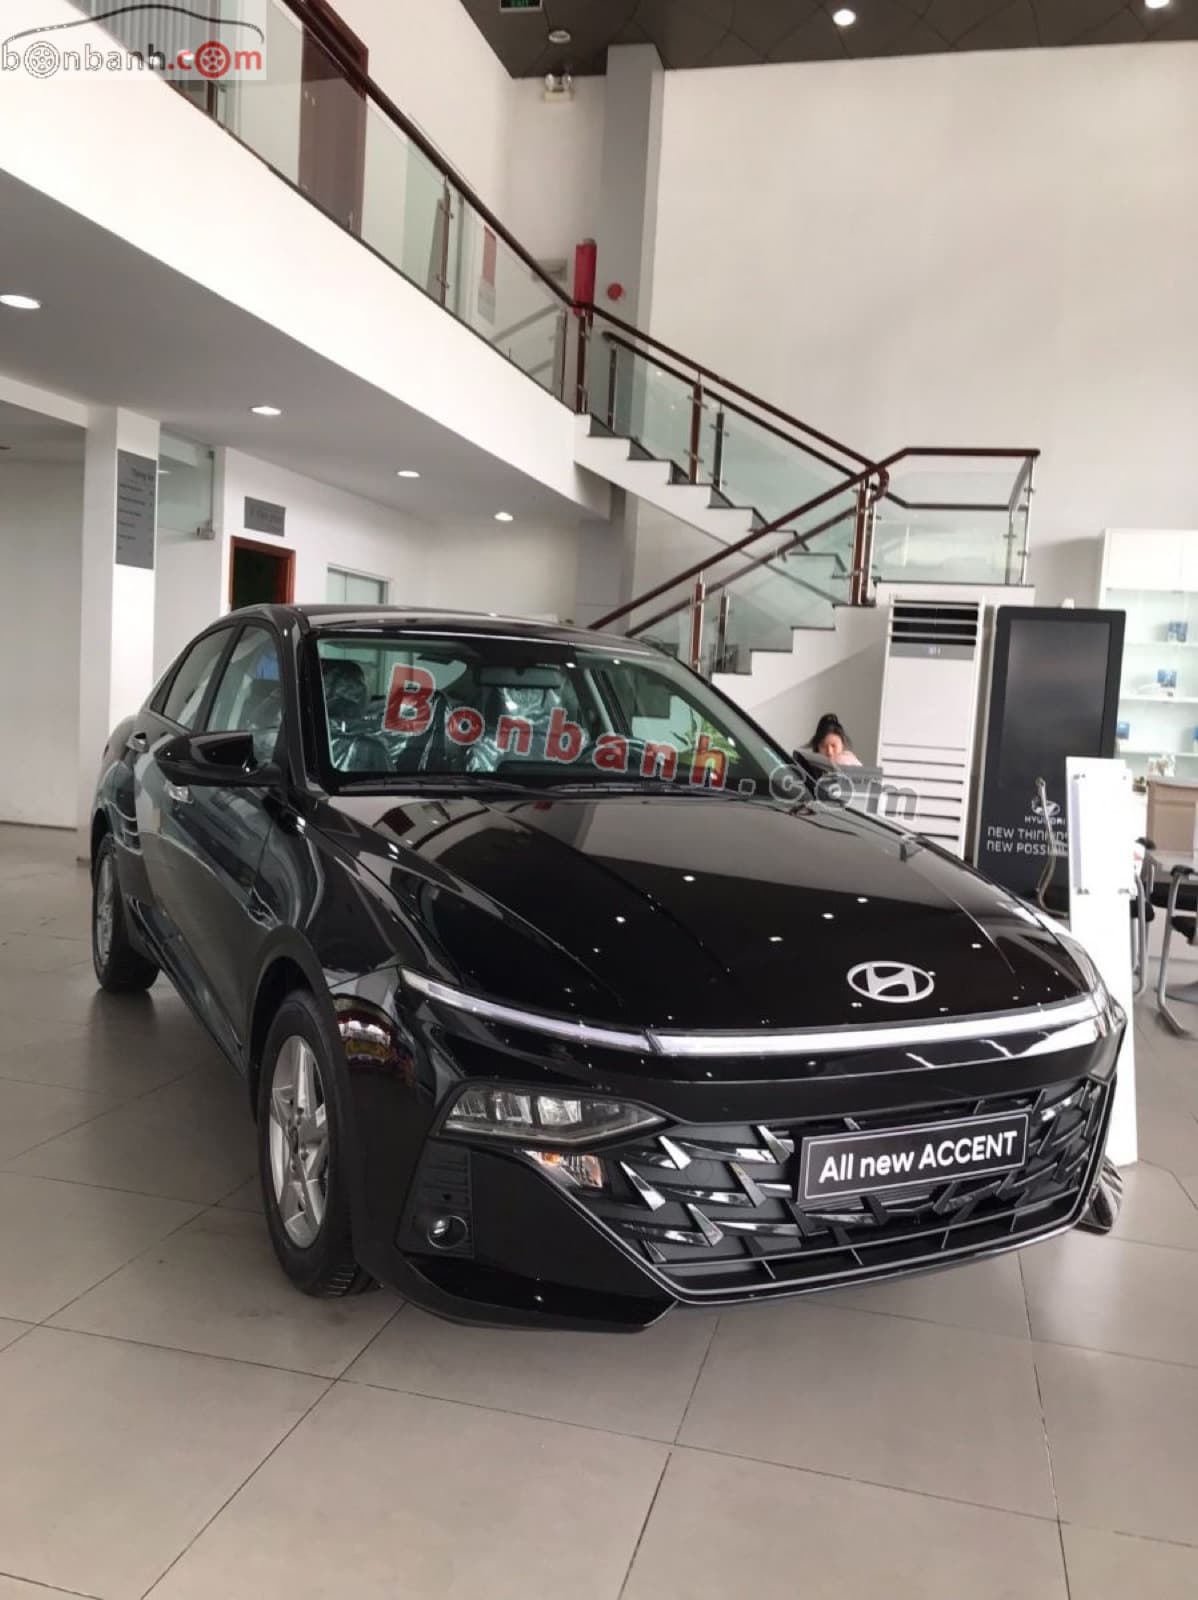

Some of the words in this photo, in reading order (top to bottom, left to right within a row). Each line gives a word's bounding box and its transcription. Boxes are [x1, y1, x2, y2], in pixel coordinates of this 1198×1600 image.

[987, 826, 1015, 839] NEW
[986, 840, 1014, 853] NEW
[819, 1153, 854, 1184] All
[859, 1151, 915, 1178] new
[918, 1130, 1018, 1170] ACCENT
